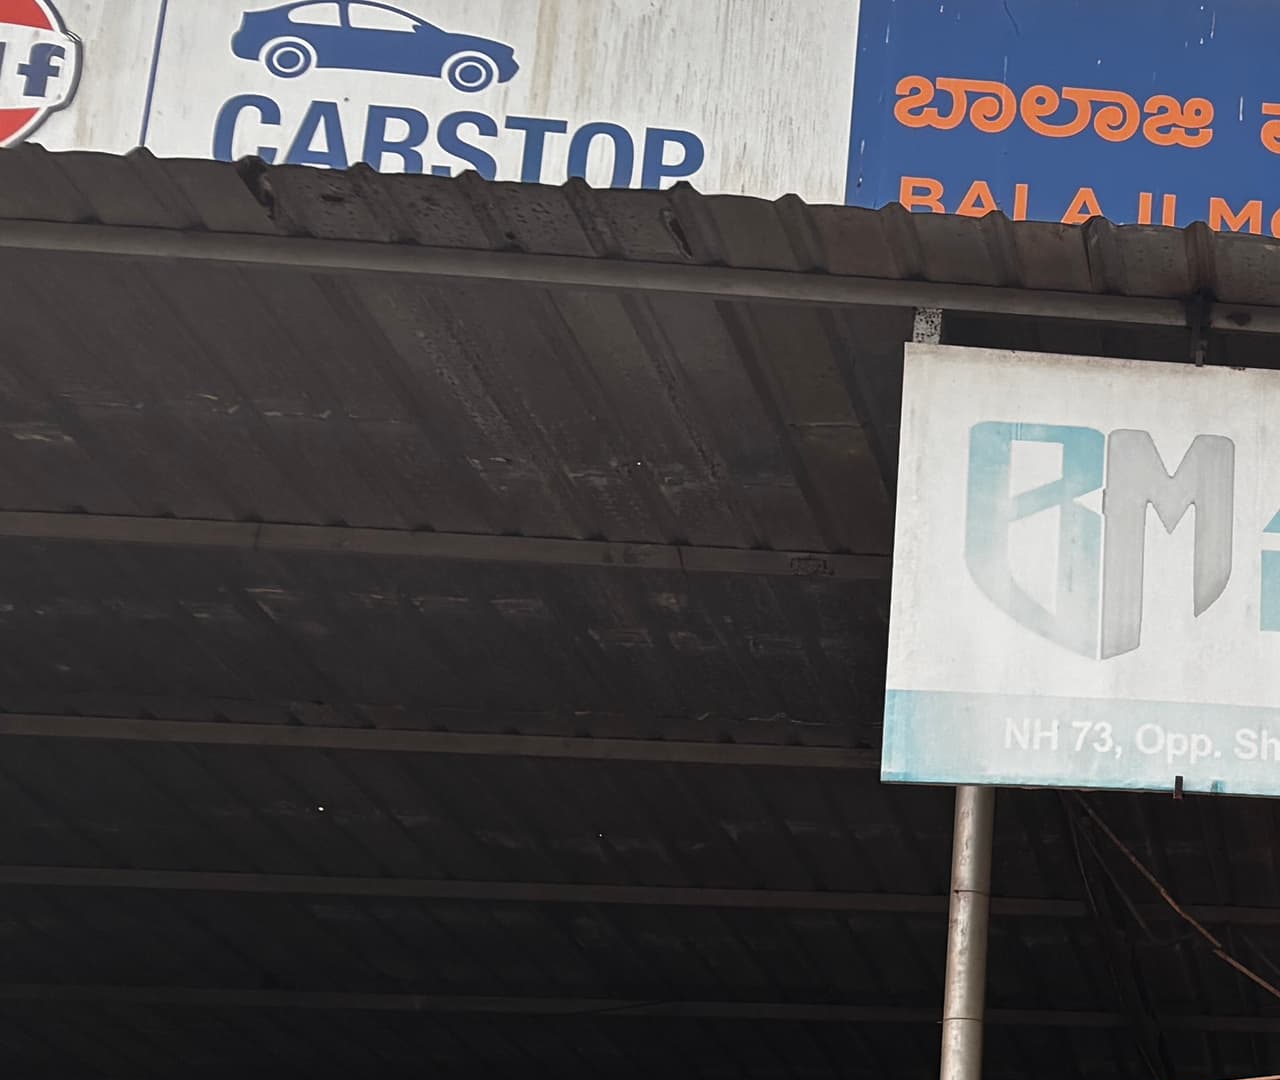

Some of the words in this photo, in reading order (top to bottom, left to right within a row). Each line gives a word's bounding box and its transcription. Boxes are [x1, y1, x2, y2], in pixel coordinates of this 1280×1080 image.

[894, 75, 1215, 148] ಬಾಲಾಜಿ
[1003, 718, 1060, 752] NH
[1071, 720, 1123, 759] 73,
[1136, 722, 1223, 763] Opp.
